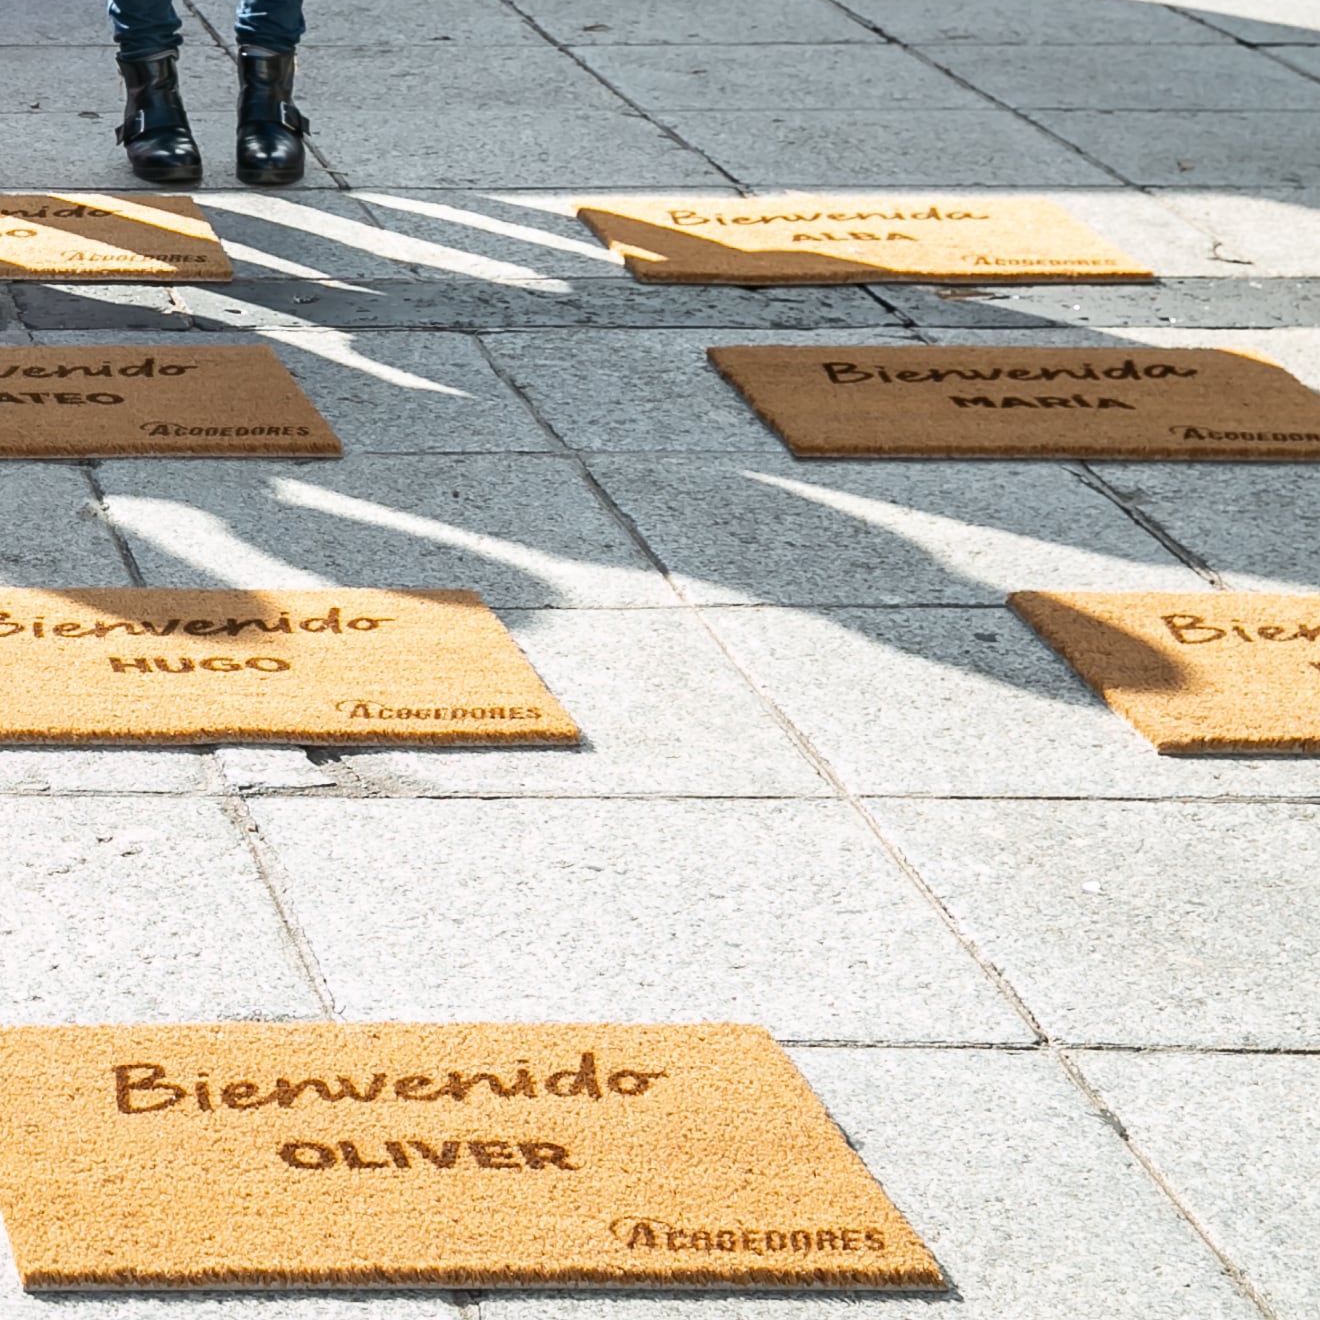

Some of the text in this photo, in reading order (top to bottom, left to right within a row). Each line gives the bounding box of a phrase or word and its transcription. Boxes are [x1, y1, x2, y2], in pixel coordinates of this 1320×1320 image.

[667, 207, 991, 226] Bienvenida
[792, 231, 922, 243] ALBA
[821, 358, 1199, 384] Bienvenida
[949, 393, 1137, 410] MARÍA
[139, 420, 310, 437] ACOGEDORES
[1169, 424, 1320, 443] ACOGEDOR
[107, 655, 292, 674] HUGO
[112, 1052, 666, 1115] Bienvenido
[277, 1138, 582, 1172] OLIVER
[609, 1216, 888, 1254] ACOGEDORES
